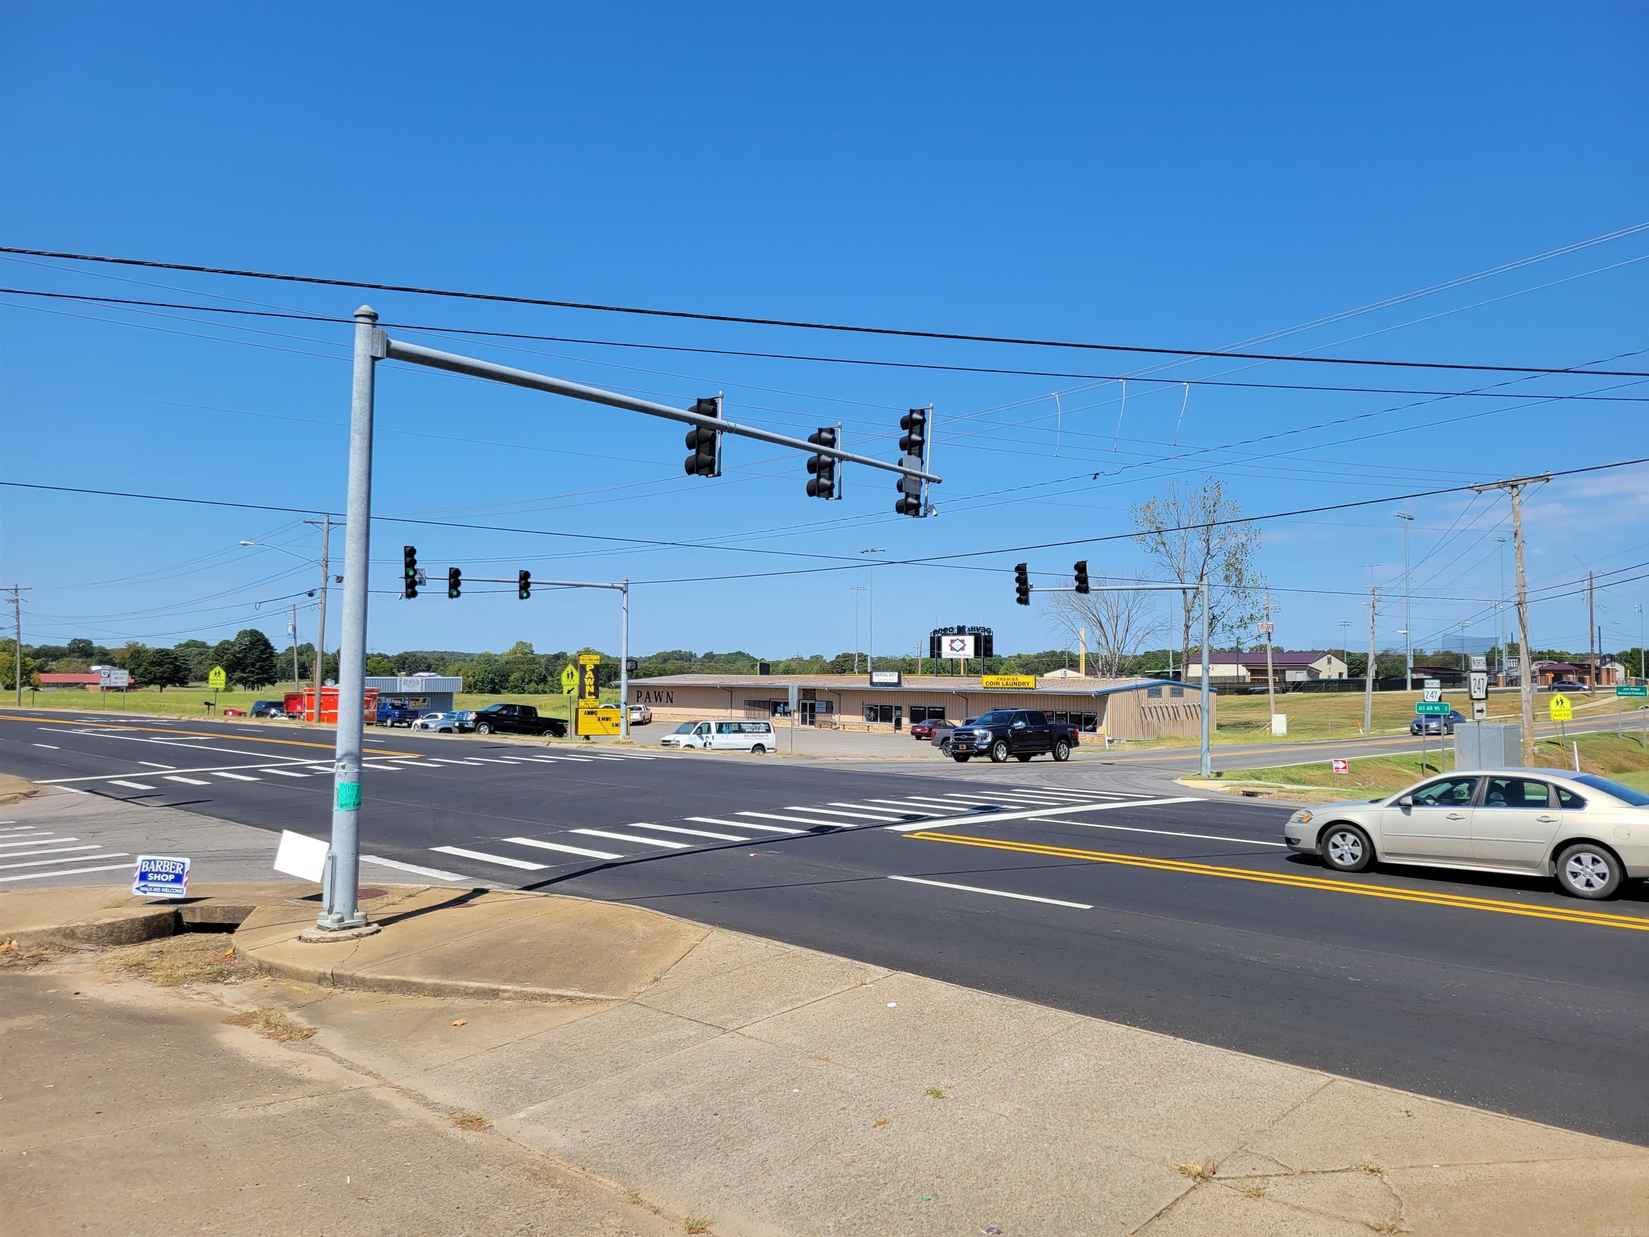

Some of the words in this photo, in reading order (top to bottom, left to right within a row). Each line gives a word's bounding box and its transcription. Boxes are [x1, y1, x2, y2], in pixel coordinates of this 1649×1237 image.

[1473, 677, 1485, 695] 247
[636, 690, 674, 704] PAWN
[1425, 690, 1438, 700] 247
[142, 861, 183, 874] BARBER
[148, 872, 175, 881] SHOP
